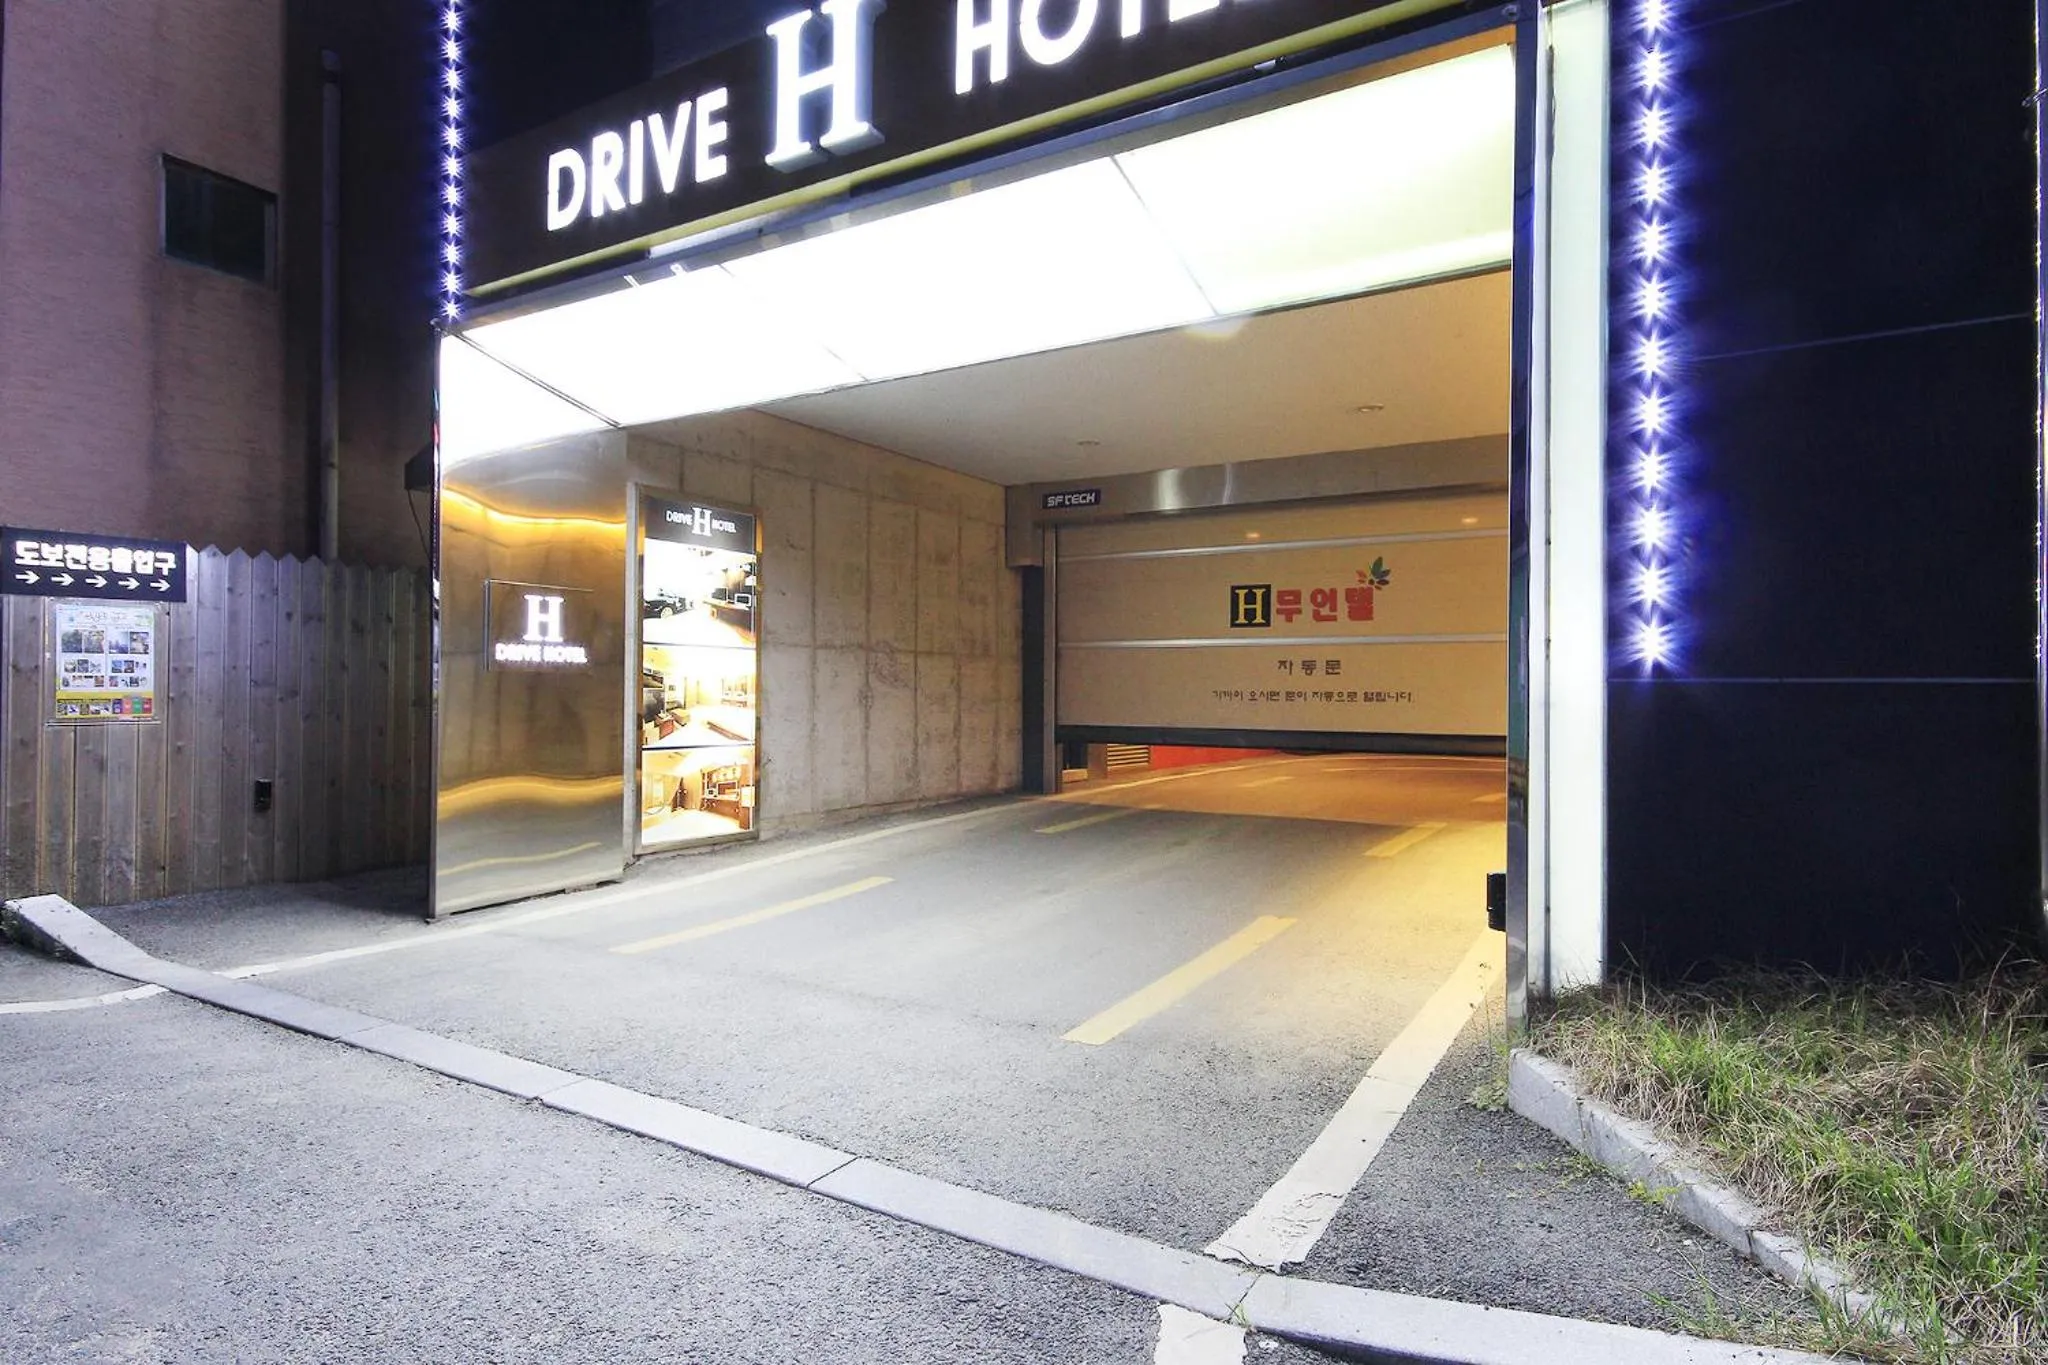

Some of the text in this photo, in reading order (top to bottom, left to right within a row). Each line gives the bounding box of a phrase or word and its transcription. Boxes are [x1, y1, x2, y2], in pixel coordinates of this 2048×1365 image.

[547, 0, 1220, 232] DRIVE H HO
[665, 507, 737, 537] DRIVE H HOTEL
[522, 594, 565, 643] H
[1235, 586, 1374, 624] H 무인텔
[1248, 690, 1280, 702] 오시면
[1312, 691, 1357, 703] 자동으로
